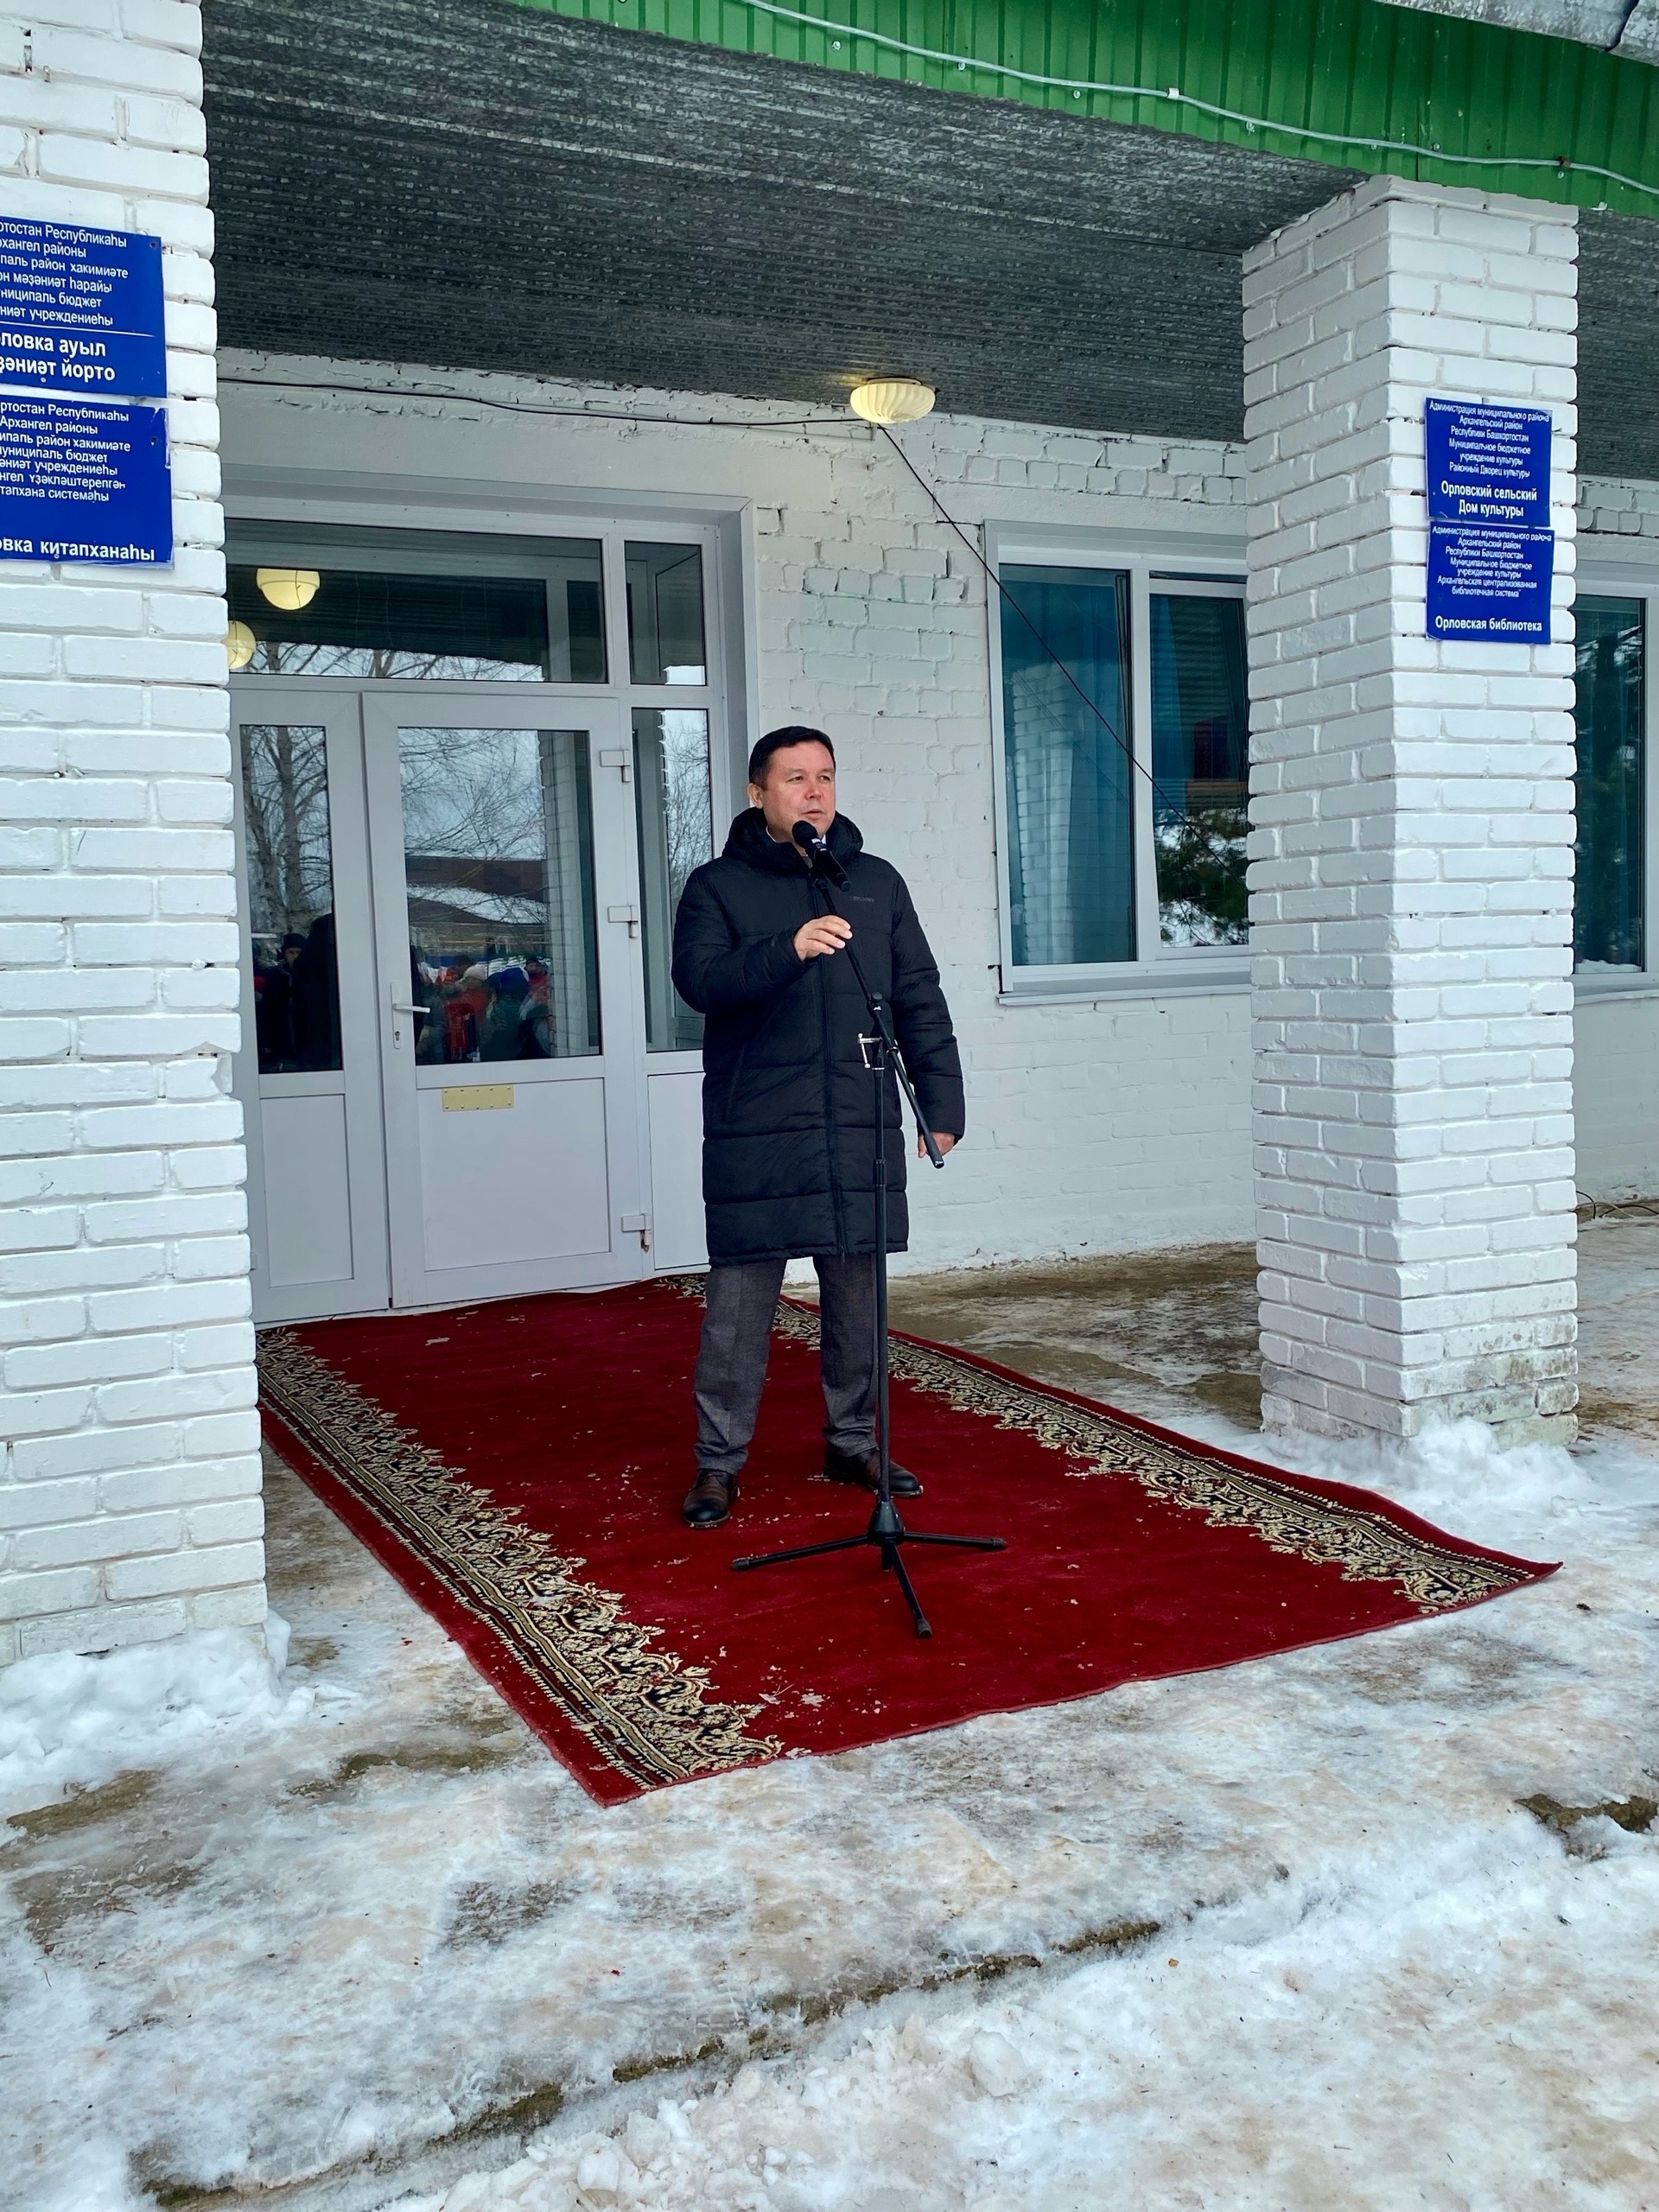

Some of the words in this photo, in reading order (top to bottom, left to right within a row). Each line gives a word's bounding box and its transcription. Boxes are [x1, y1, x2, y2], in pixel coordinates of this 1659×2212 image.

[46, 225, 126, 248] Республикаһы
[0, 238, 40, 252] хангел
[43, 241, 86, 257] районы
[31, 257, 66, 271] район
[70, 263, 129, 279] хакимиәте
[13, 272, 67, 288] мәҙәниәт
[69, 276, 112, 293] һарайы
[0, 289, 56, 303] ниципаль
[59, 291, 102, 308] бюджет
[29, 308, 113, 327] учреждениеһы
[0, 332, 54, 352] ловка
[59, 338, 106, 359] ауыл
[61, 358, 116, 383] йорто
[0, 402, 45, 415] ртостан
[48, 404, 129, 422] Республикаһы
[1429, 400, 1477, 415] Администрация
[1477, 408, 1527, 421] муниципального
[1528, 412, 1550, 423] района
[0, 415, 52, 430] Архангел
[55, 421, 99, 435] районы
[1459, 415, 1503, 428] Архангельский
[1504, 420, 1522, 430] район
[1451, 425, 1485, 438] Республики
[1486, 429, 1529, 442] Башкортостан
[36, 434, 71, 448] район
[73, 438, 131, 452] хакимиәте
[1449, 438, 1497, 451] Муниципальное
[1497, 443, 1531, 454] бюджетное
[0, 446, 63, 460] униципаль
[66, 448, 108, 463] бюджет
[1459, 453, 1496, 463] учреждение
[1496, 456, 1523, 467] культуры
[35, 461, 118, 475] учреждениеһы
[1449, 461, 1479, 474] Районный
[1480, 465, 1503, 476] Дворец
[1503, 469, 1530, 480] культуры
[48, 489, 110, 501] системаһы
[1440, 480, 1492, 499] Орловский
[1494, 487, 1537, 501] сельский
[1459, 499, 1478, 515] Дом
[1480, 505, 1524, 519] культуры
[1432, 526, 1480, 537] Администрация
[1481, 530, 1530, 540] муниципального
[1530, 533, 1552, 542] района
[0, 538, 33, 553] вка
[40, 540, 155, 561] китапханаһы
[1458, 537, 1502, 548] Архангельский
[1503, 541, 1521, 550] район
[1446, 546, 1480, 557] Республики
[1481, 549, 1523, 560] Башкортостан
[1450, 556, 1498, 568] Муниципальное
[1499, 560, 1533, 570] бюджетное
[1437, 575, 1483, 586] Архангельская
[1483, 579, 1537, 588] централизованная
[1457, 568, 1494, 577] учреждение
[1495, 570, 1522, 580] культуры
[1452, 586, 1494, 596] библиотечная
[1495, 589, 1520, 598] система
[1435, 615, 1487, 631] Орловская
[1489, 618, 1542, 632] библиотека
